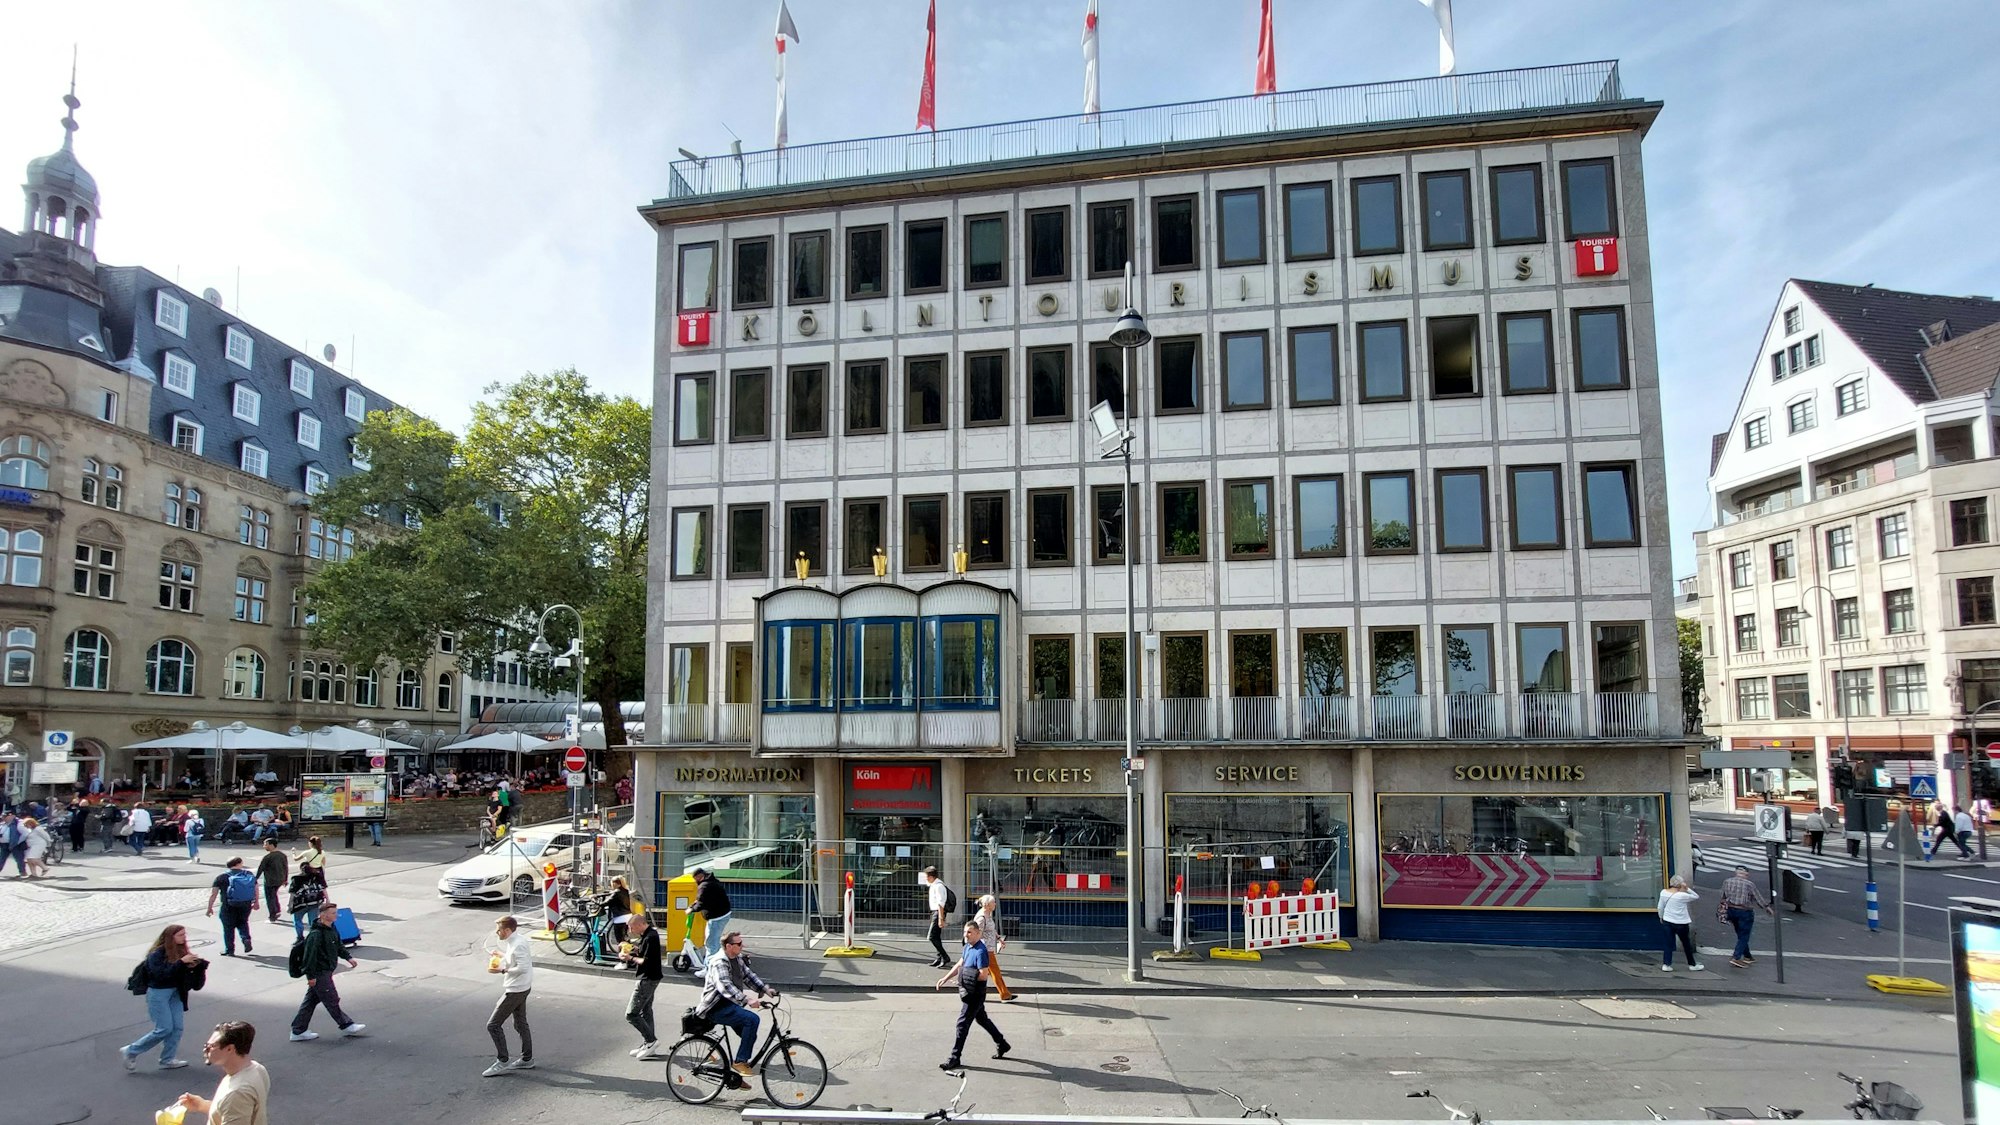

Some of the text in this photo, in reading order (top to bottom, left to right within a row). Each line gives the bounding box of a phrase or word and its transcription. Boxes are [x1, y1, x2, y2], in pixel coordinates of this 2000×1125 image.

[1580, 238, 1615, 247] TOURIST
[680, 312, 706, 321] TOURIST
[673, 767, 803, 783] INFORMATION
[856, 770, 880, 780] Köln
[1013, 767, 1092, 783] TICKETS
[1215, 766, 1299, 781] SERVICE
[1454, 765, 1586, 781] SOUVENIRS
